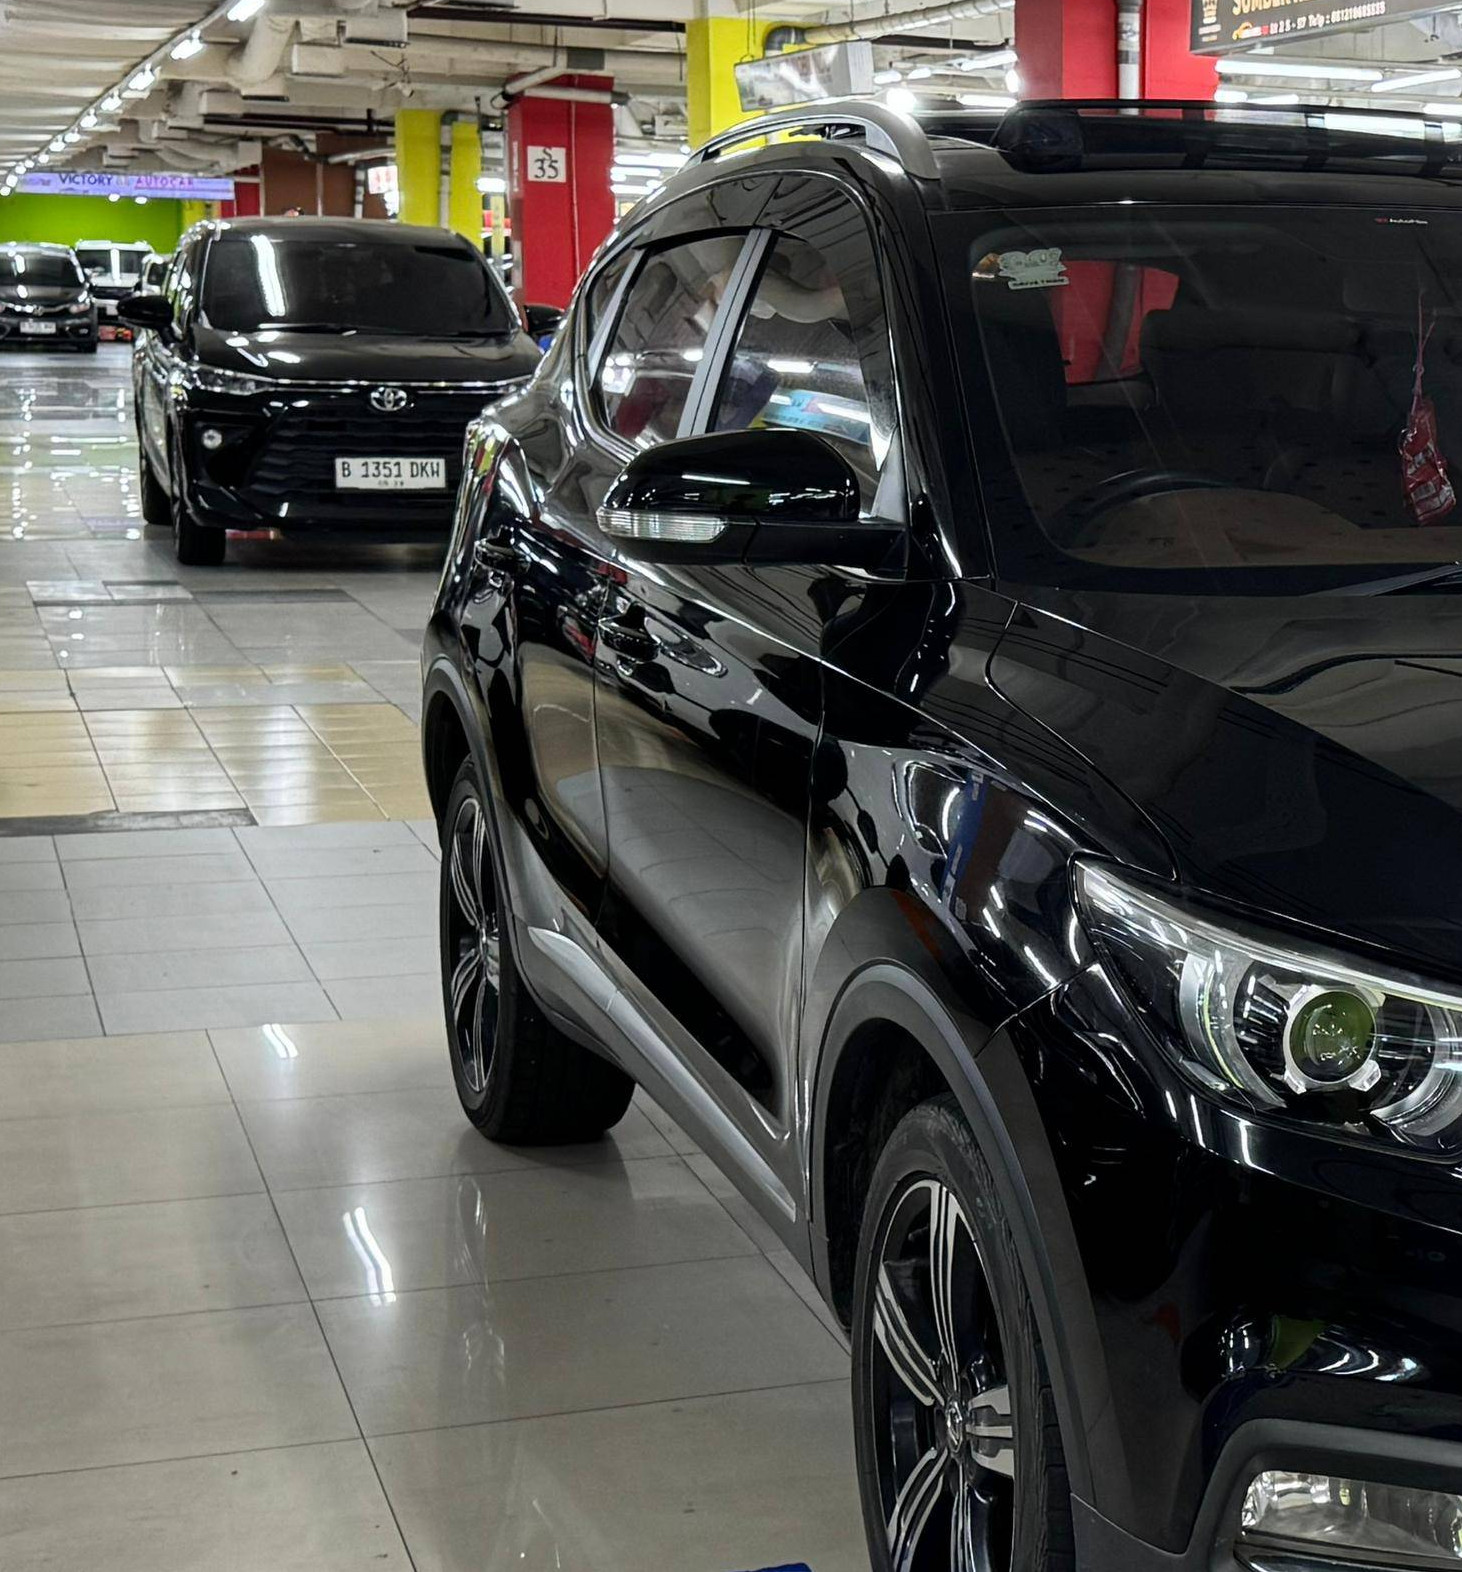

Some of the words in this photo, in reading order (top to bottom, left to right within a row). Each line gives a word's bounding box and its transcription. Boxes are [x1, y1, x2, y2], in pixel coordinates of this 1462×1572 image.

[534, 159, 558, 179] 35
[59, 174, 113, 186] VICTORY
[342, 461, 351, 478] B
[361, 461, 402, 478] 1351
